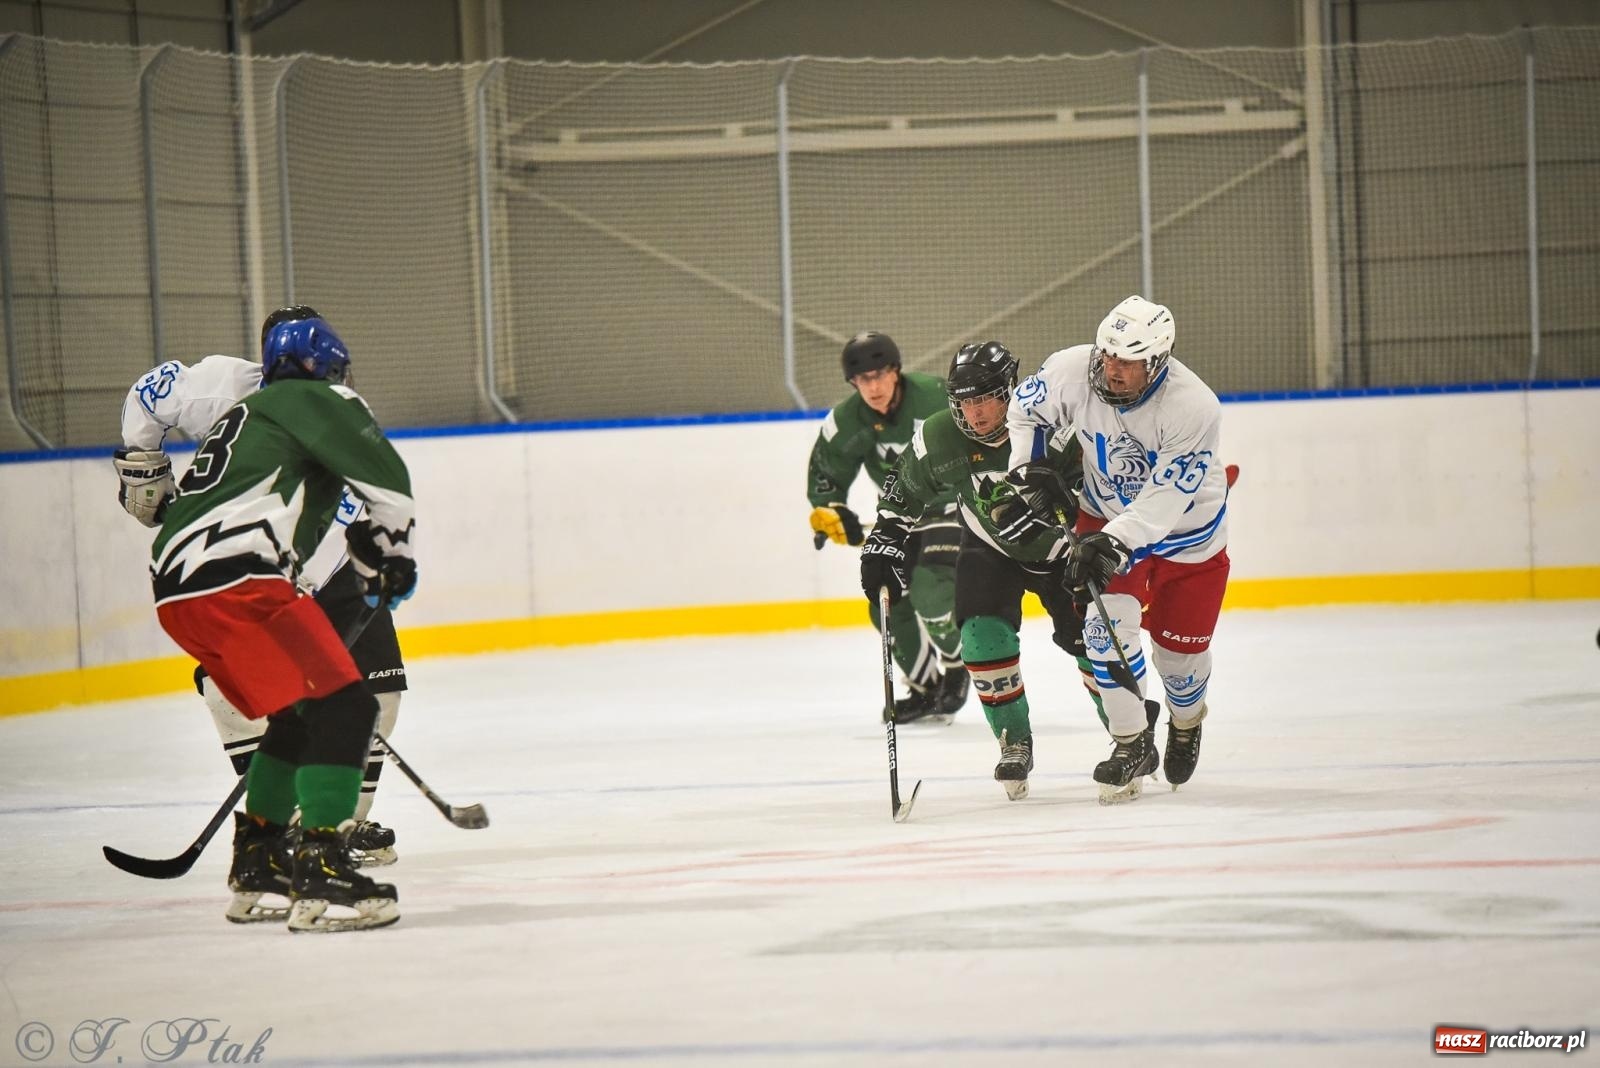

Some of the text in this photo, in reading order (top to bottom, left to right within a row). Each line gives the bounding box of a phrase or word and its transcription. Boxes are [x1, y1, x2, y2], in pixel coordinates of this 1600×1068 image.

[178, 402, 249, 496] 3
[1152, 450, 1212, 494] 66
[1162, 630, 1212, 644] EASTON
